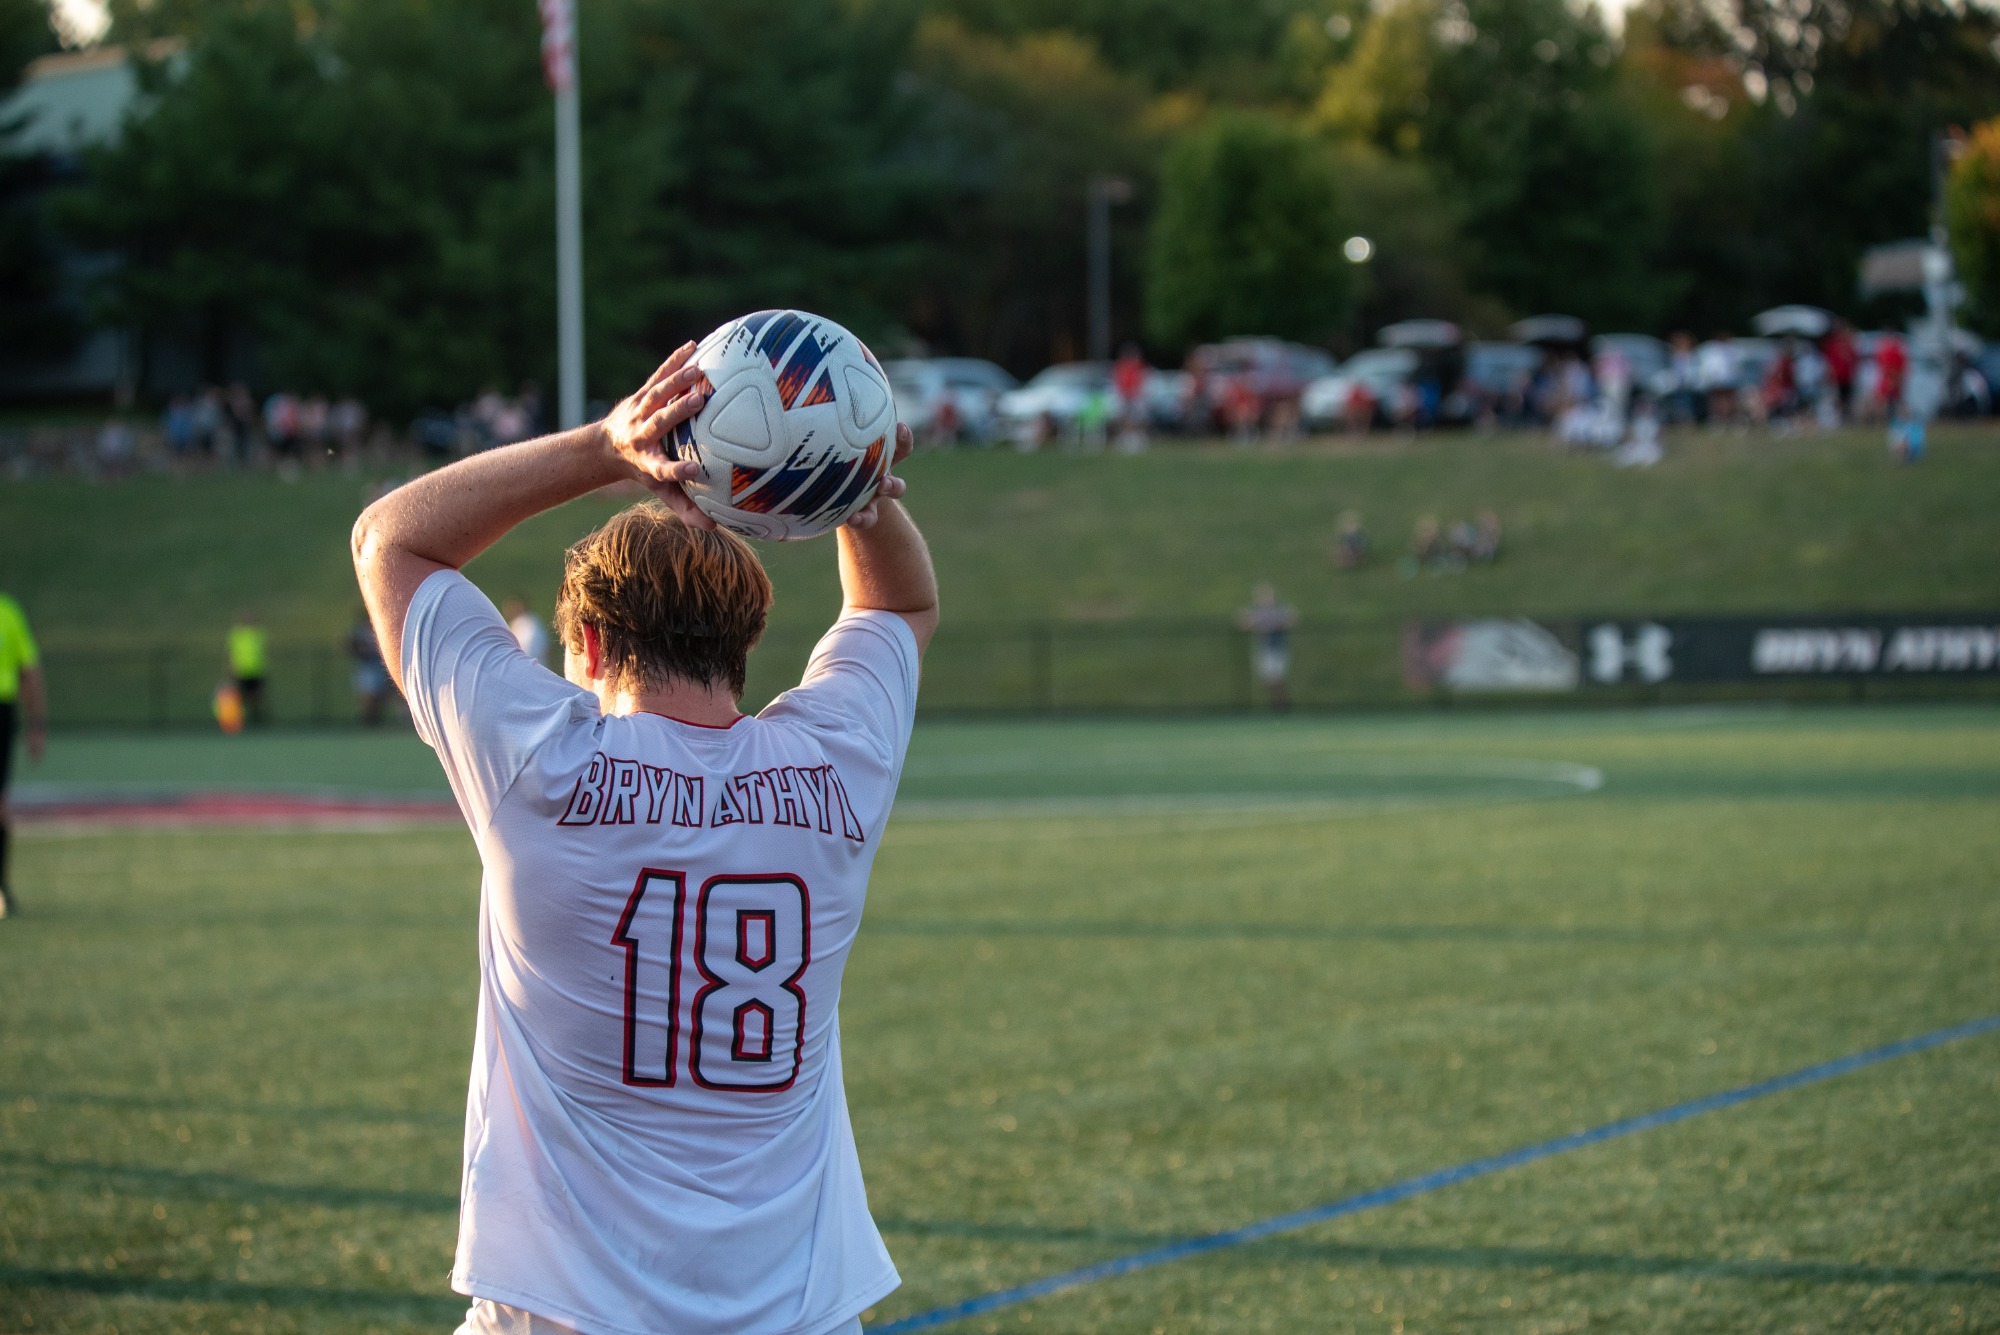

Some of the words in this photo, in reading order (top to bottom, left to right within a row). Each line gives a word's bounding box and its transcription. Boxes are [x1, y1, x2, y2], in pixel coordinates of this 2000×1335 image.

[1753, 627, 1881, 672] BRYN
[556, 752, 703, 828] BRYN
[610, 867, 811, 1093] 18
